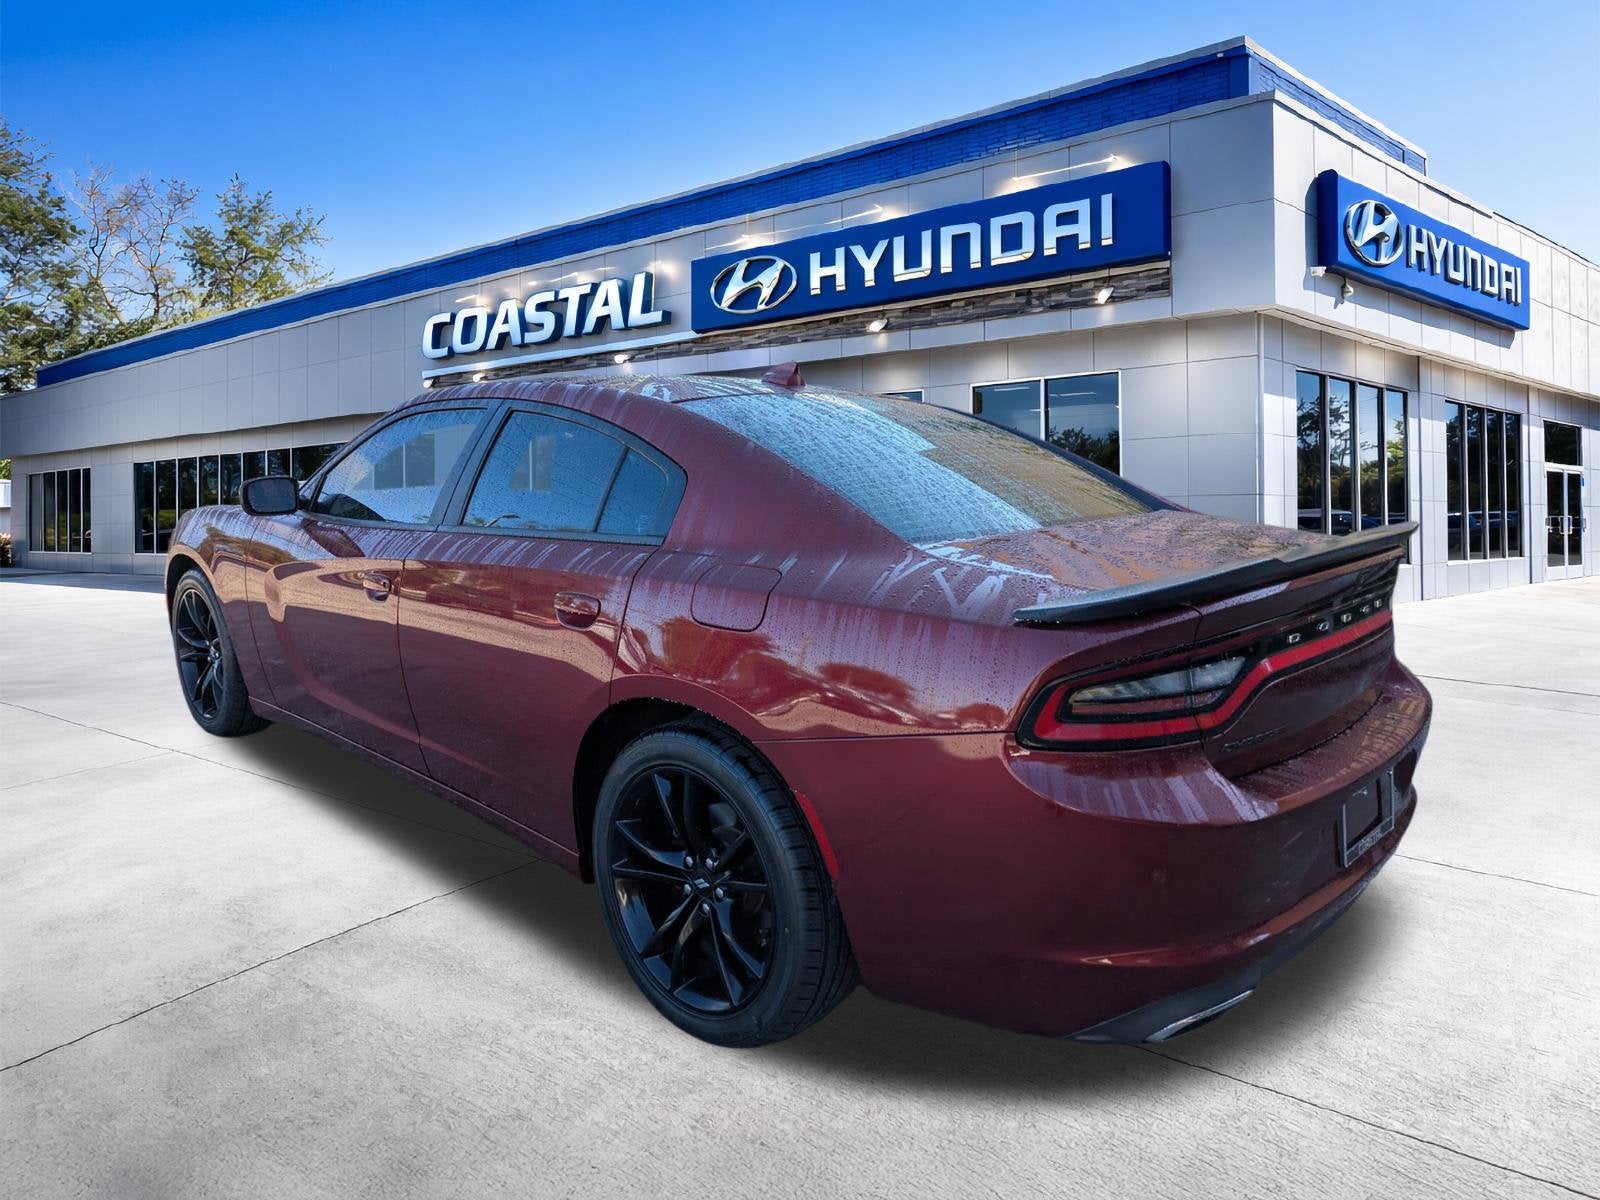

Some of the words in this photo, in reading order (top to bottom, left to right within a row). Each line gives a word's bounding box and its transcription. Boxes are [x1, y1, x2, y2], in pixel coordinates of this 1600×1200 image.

[809, 192, 1115, 296] HYUNDAI
[1406, 223, 1522, 306] HYUNDAI
[421, 270, 669, 360] COASTAL
[1287, 598, 1384, 645] DODGE
